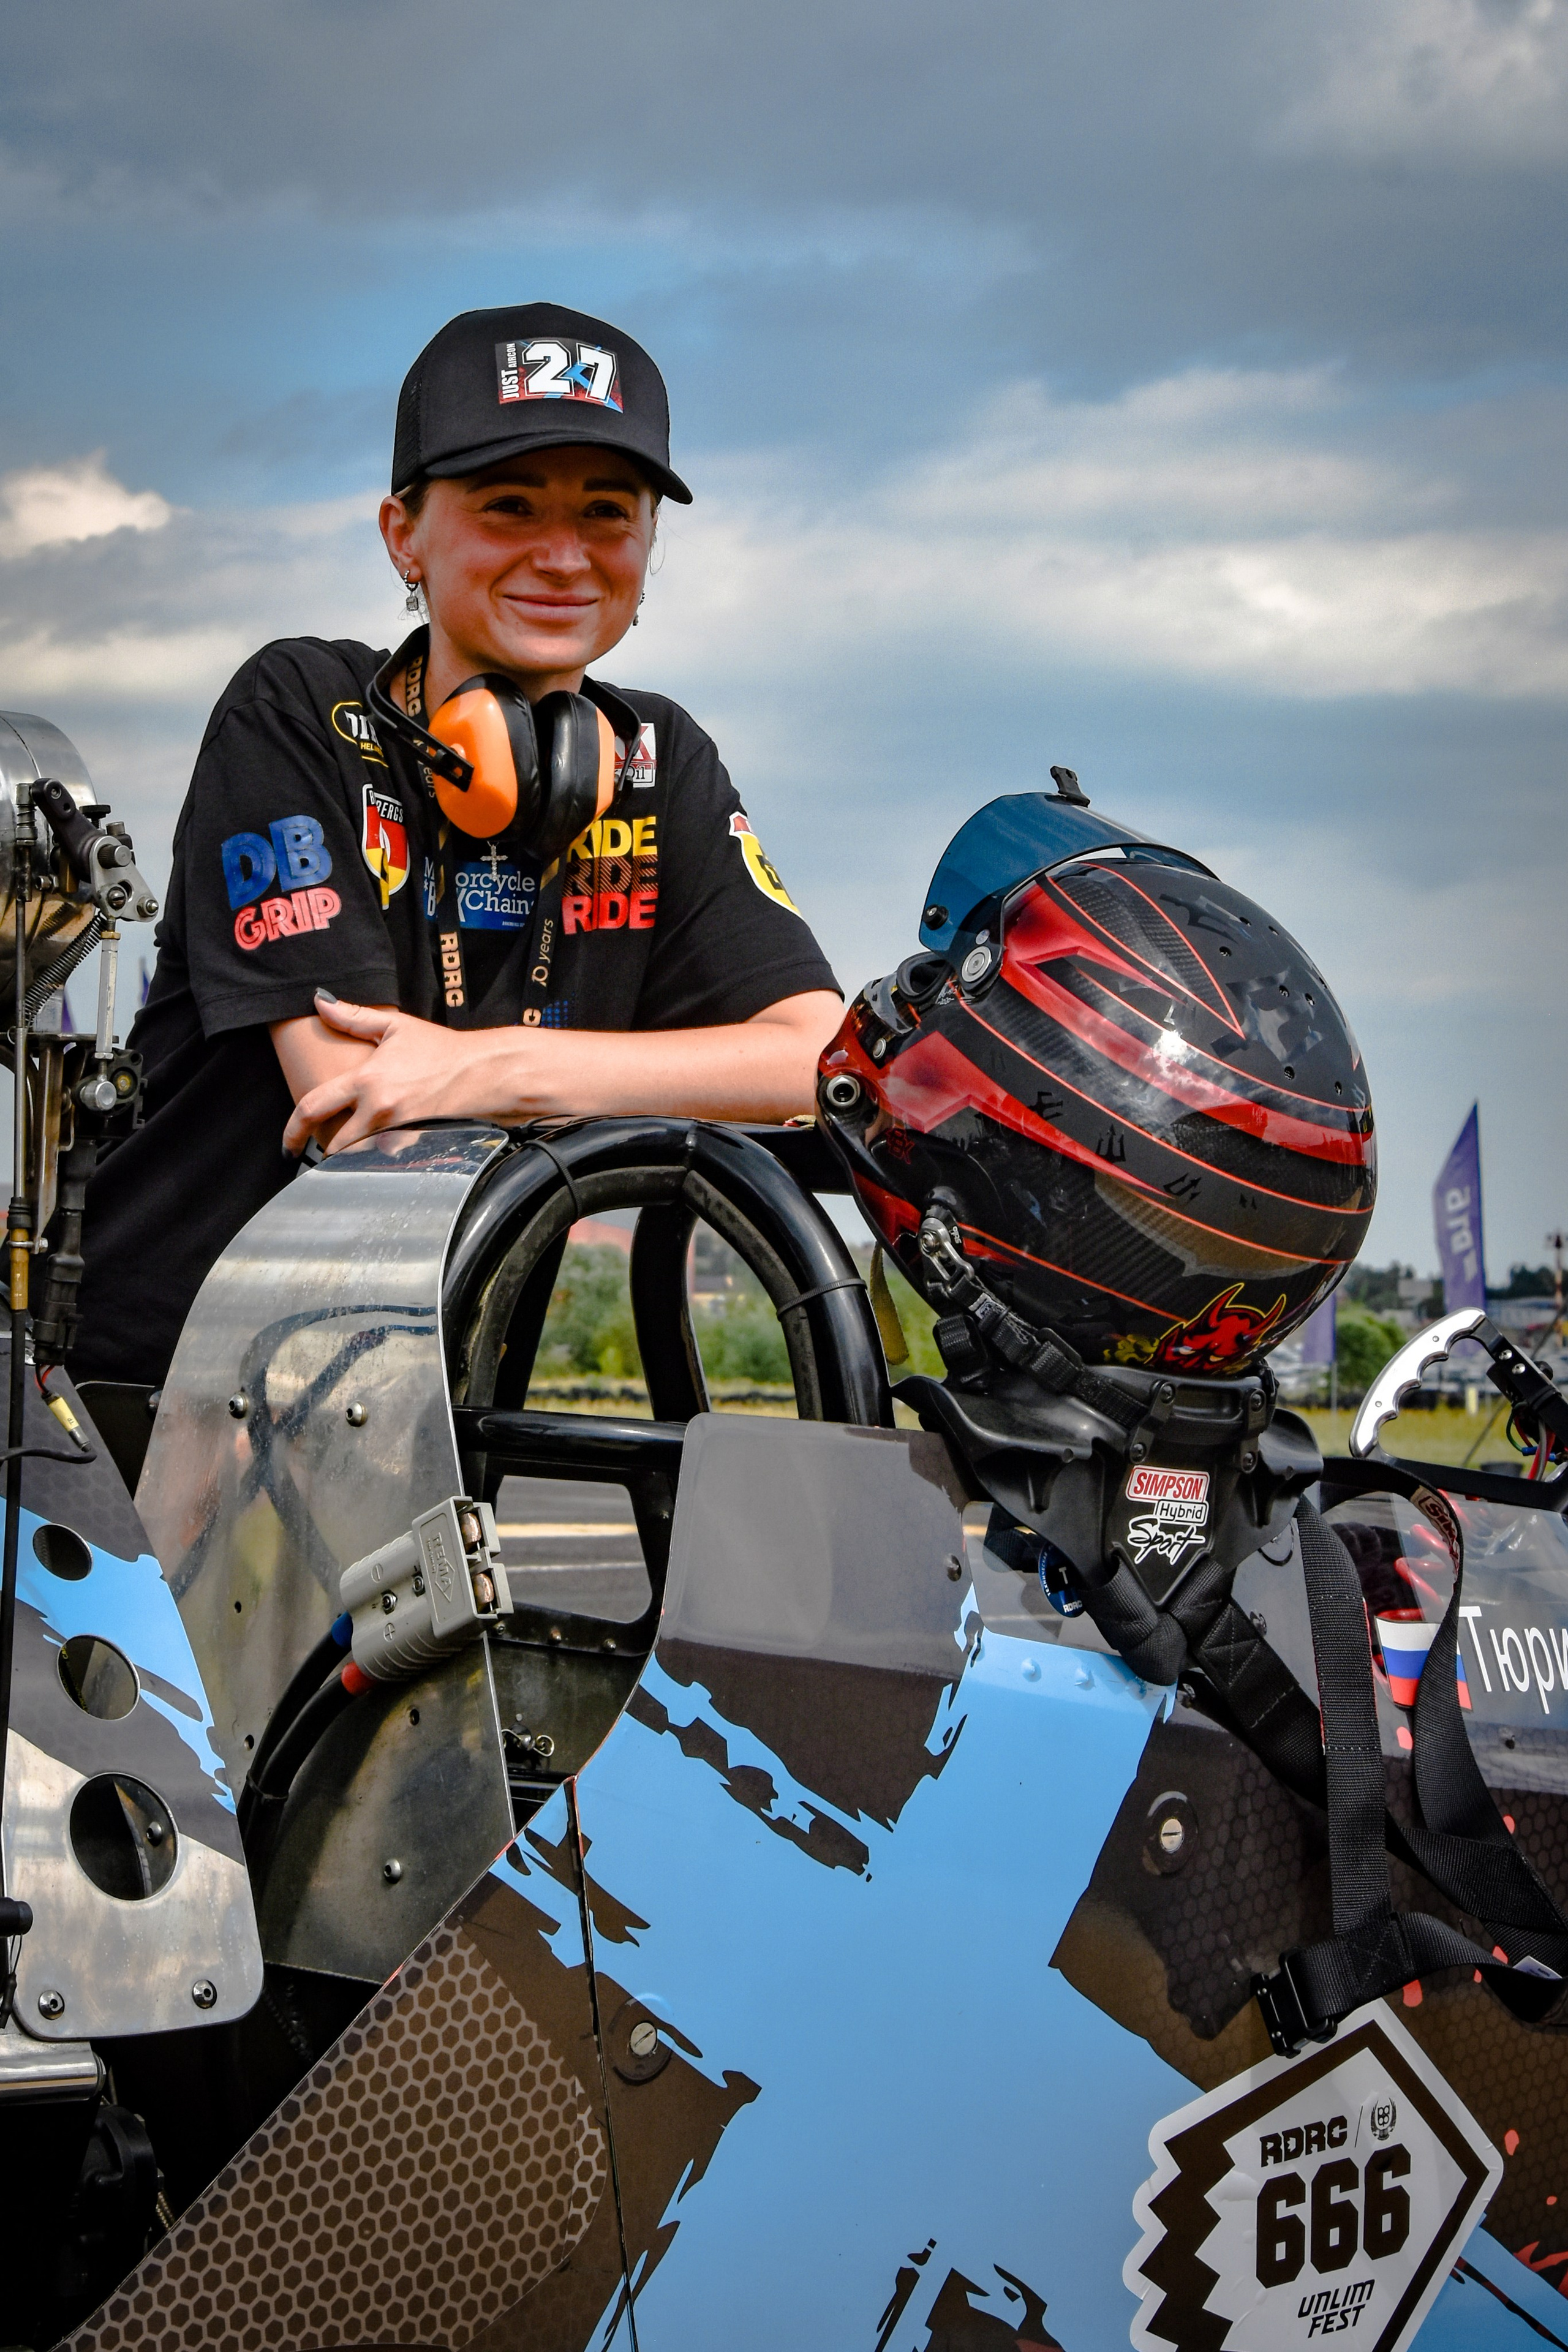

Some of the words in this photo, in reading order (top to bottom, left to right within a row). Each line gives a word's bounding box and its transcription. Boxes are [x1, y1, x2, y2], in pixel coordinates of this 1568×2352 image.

[506, 342, 518, 368] AIRCON
[522, 340, 616, 404] 27
[501, 369, 519, 399] JUST
[567, 816, 658, 862] RIDE
[221, 815, 333, 911] DB
[562, 854, 658, 898] RIDE
[234, 886, 342, 951] GRIP
[562, 890, 659, 935] RIDE
[538, 919, 554, 964] years
[440, 932, 464, 1008] RDRC
[1133, 1472, 1204, 1501] SIMPSON
[1159, 1502, 1204, 1521] Hybrid
[1129, 1517, 1205, 1563] Sport
[1063, 1600, 1082, 1613] RDRC
[1259, 2115, 1348, 2168] RDRC
[1256, 2143, 1411, 2289] 666
[1297, 2279, 1376, 2318] UNLIM
[1307, 2304, 1366, 2339] FEST
